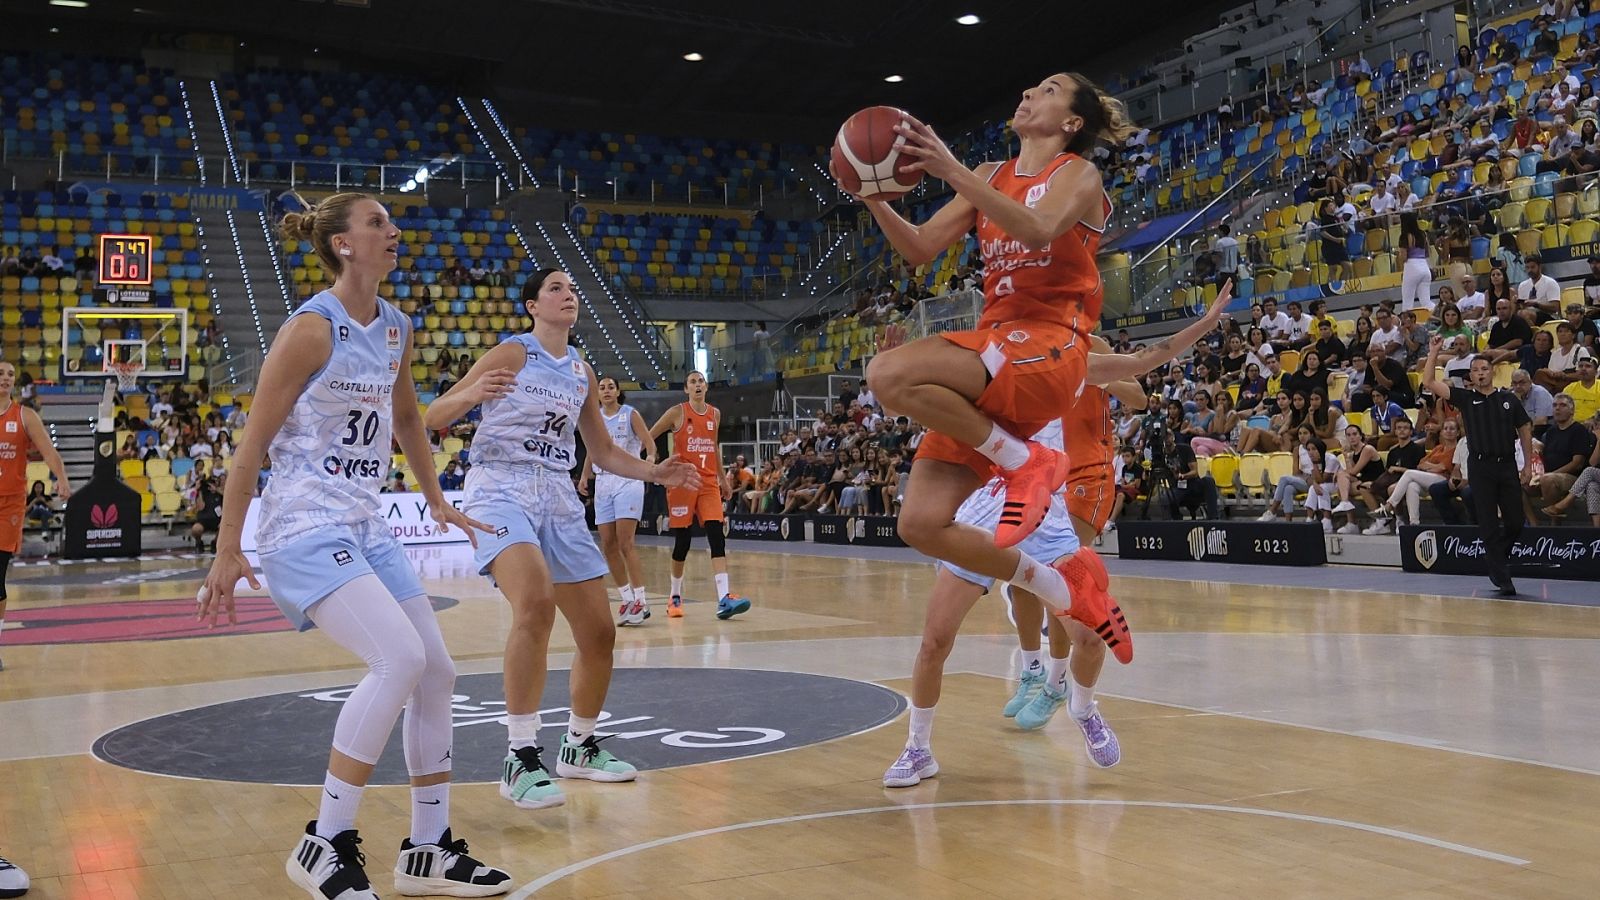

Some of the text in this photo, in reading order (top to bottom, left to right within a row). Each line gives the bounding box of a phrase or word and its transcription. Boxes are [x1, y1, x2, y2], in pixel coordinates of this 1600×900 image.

[1571, 244, 1591, 257] GRAN
[110, 254, 125, 278] 0
[329, 380, 373, 393] CASTILLA
[525, 385, 564, 400] CASTILLA
[342, 409, 380, 446] 30
[539, 411, 568, 437] 34
[699, 454, 707, 468] 7
[415, 502, 428, 521] Y
[821, 524, 836, 533] 1923
[877, 526, 893, 536] 2023
[1135, 526, 1289, 561] 1923 100 AÑOS 2023
[1419, 539, 1433, 562] 100
[1536, 536, 1587, 561] Nuestro
